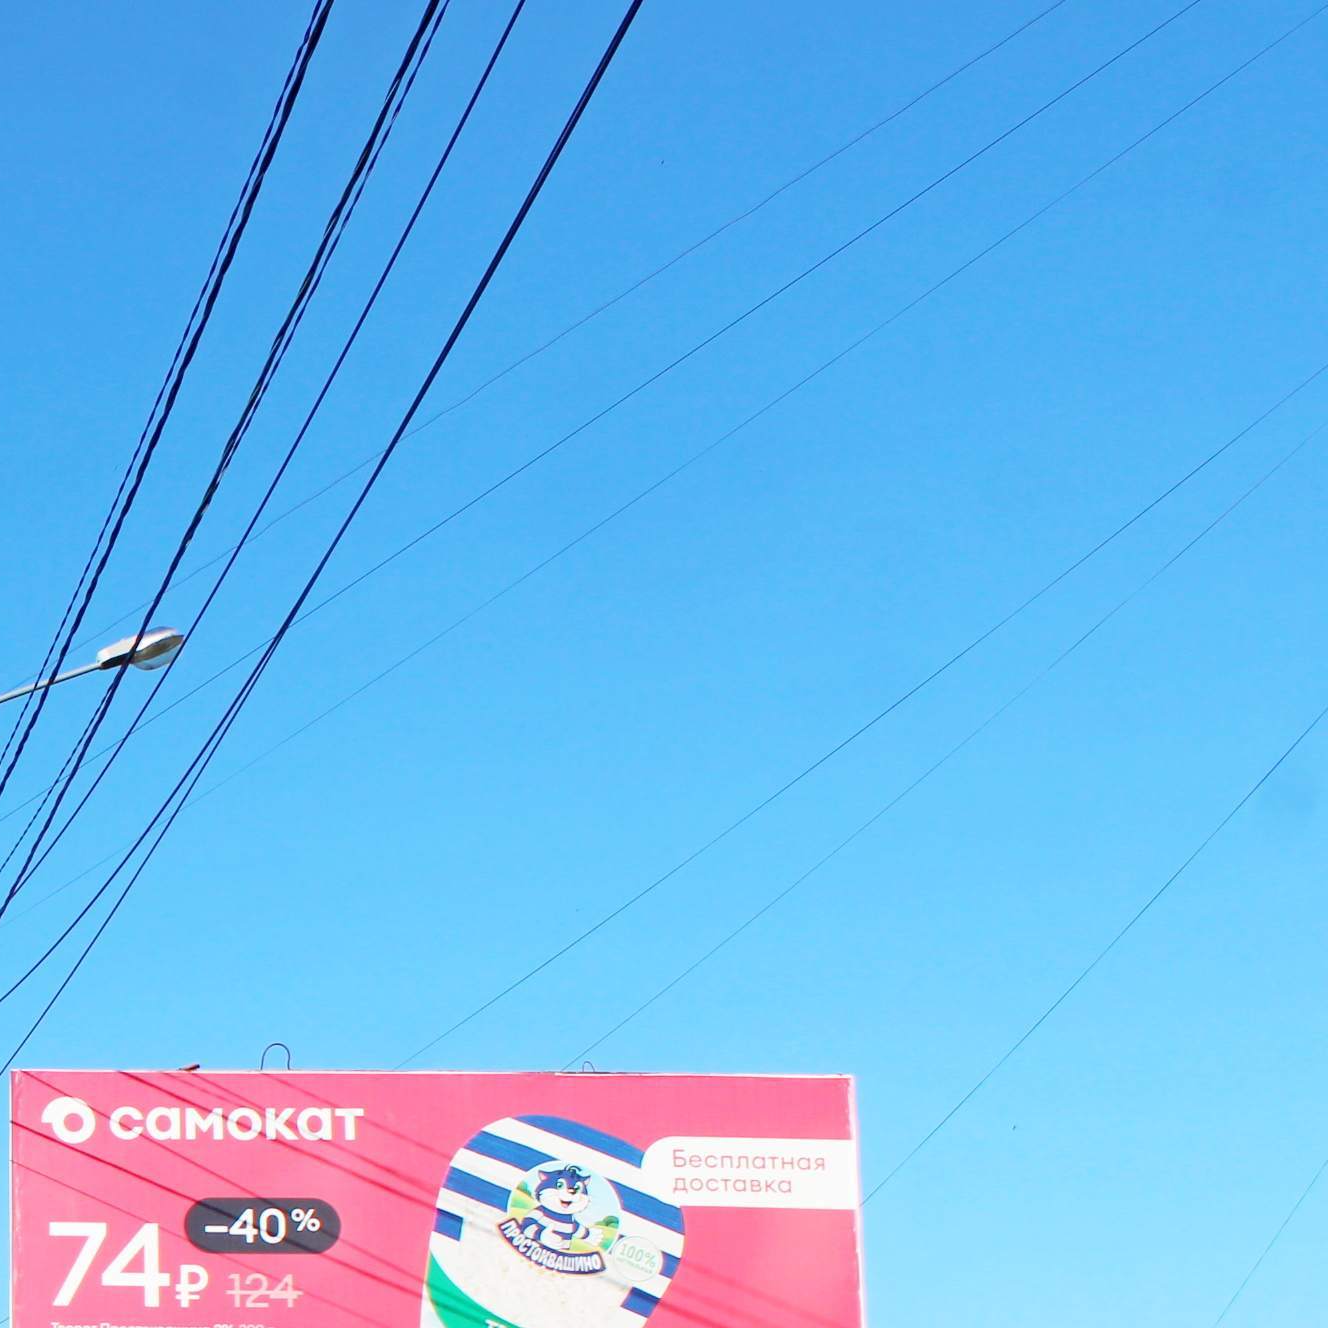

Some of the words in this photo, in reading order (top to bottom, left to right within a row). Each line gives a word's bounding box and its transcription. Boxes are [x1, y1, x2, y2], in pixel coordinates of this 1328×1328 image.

[109, 1105, 365, 1141] самокат
[672, 1148, 825, 1171] Бесплатная
[672, 1176, 793, 1194] доставка
[499, 1219, 603, 1273] ПРОСТОКВАШИНО
[224, 1273, 304, 1308] 124
